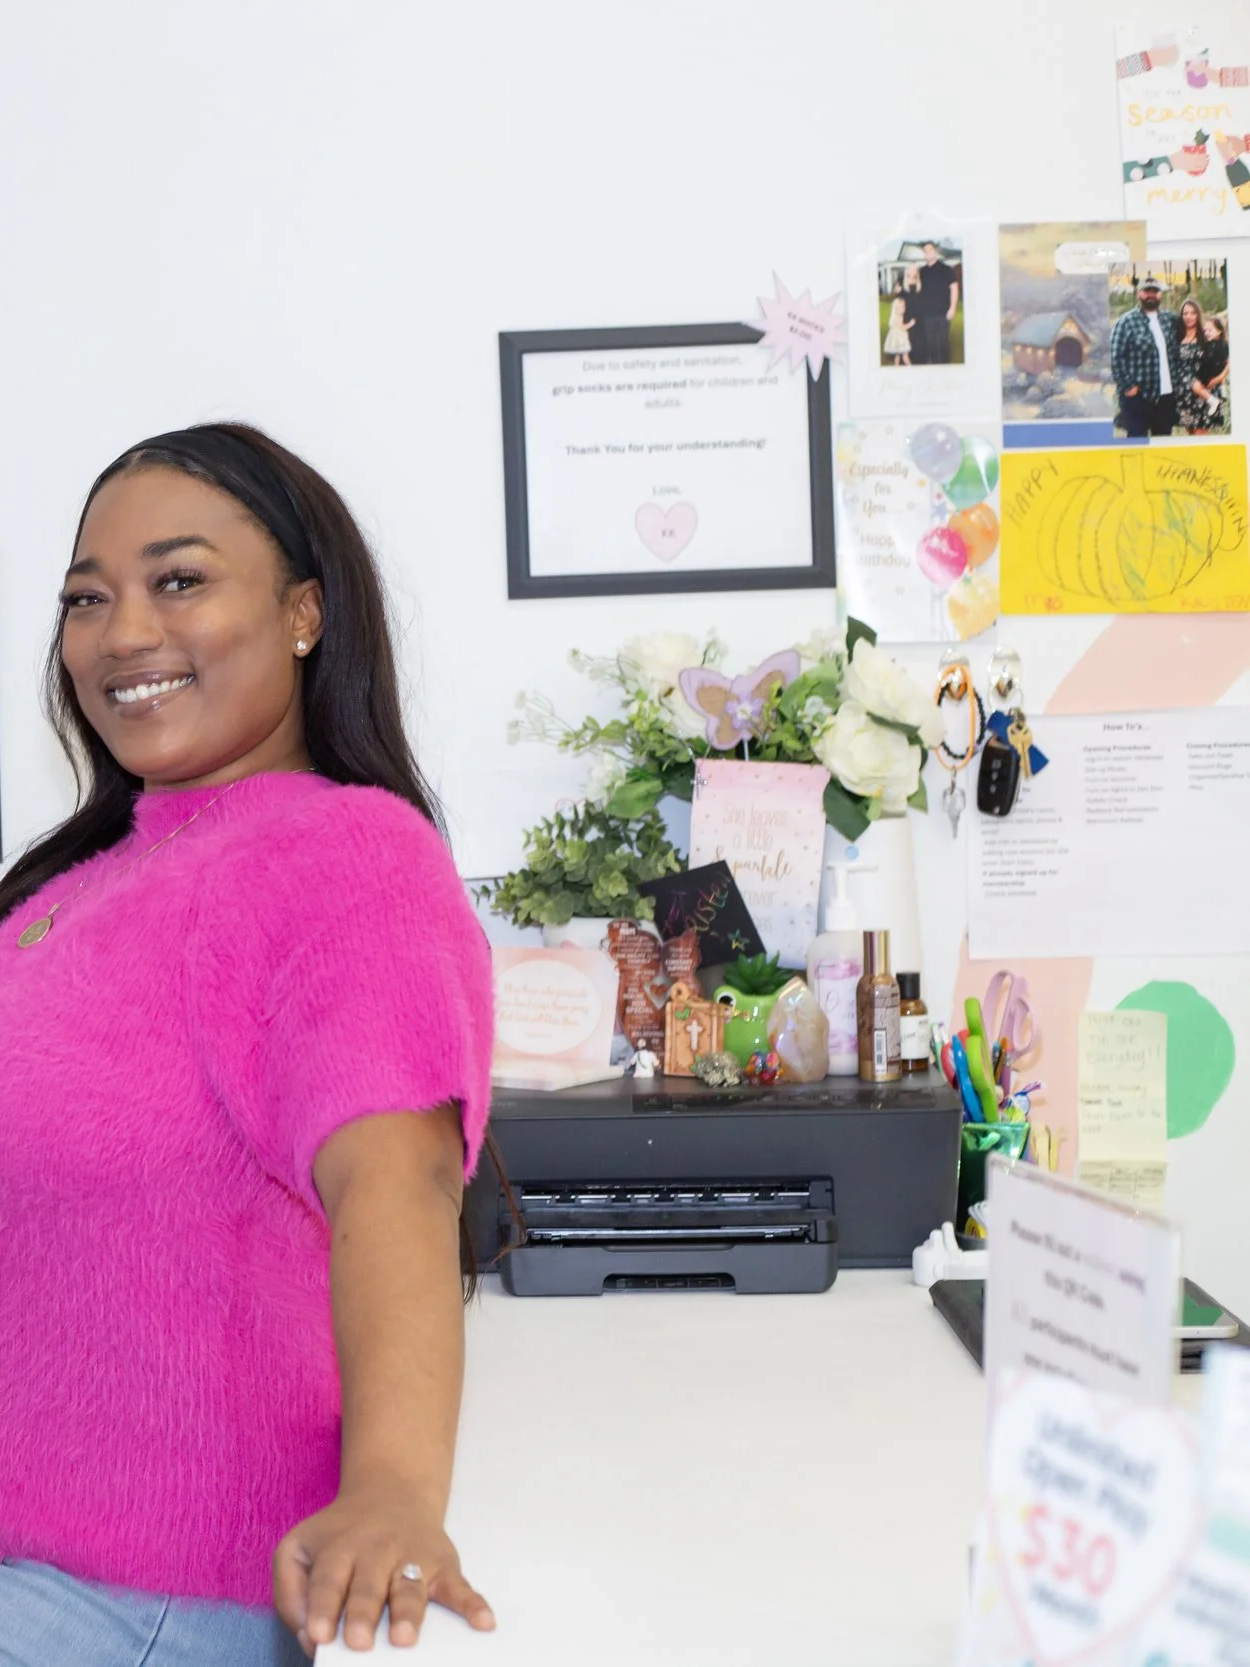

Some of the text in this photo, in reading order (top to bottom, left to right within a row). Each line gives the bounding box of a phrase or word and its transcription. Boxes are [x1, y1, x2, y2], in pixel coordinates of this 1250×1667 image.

[1146, 187, 1227, 217] merry
[583, 354, 744, 373] Due to safety and sanitation,
[552, 375, 779, 397] grip socks are required for children and
[565, 437, 767, 456] Thank You for your understanding!
[848, 461, 910, 481] Especially
[1005, 460, 1059, 530] HAPPY
[860, 532, 895, 548] Happ
[722, 802, 790, 828] She leaves
[1037, 1410, 1158, 1494] Unlimited
[1018, 1501, 1116, 1598] $30
